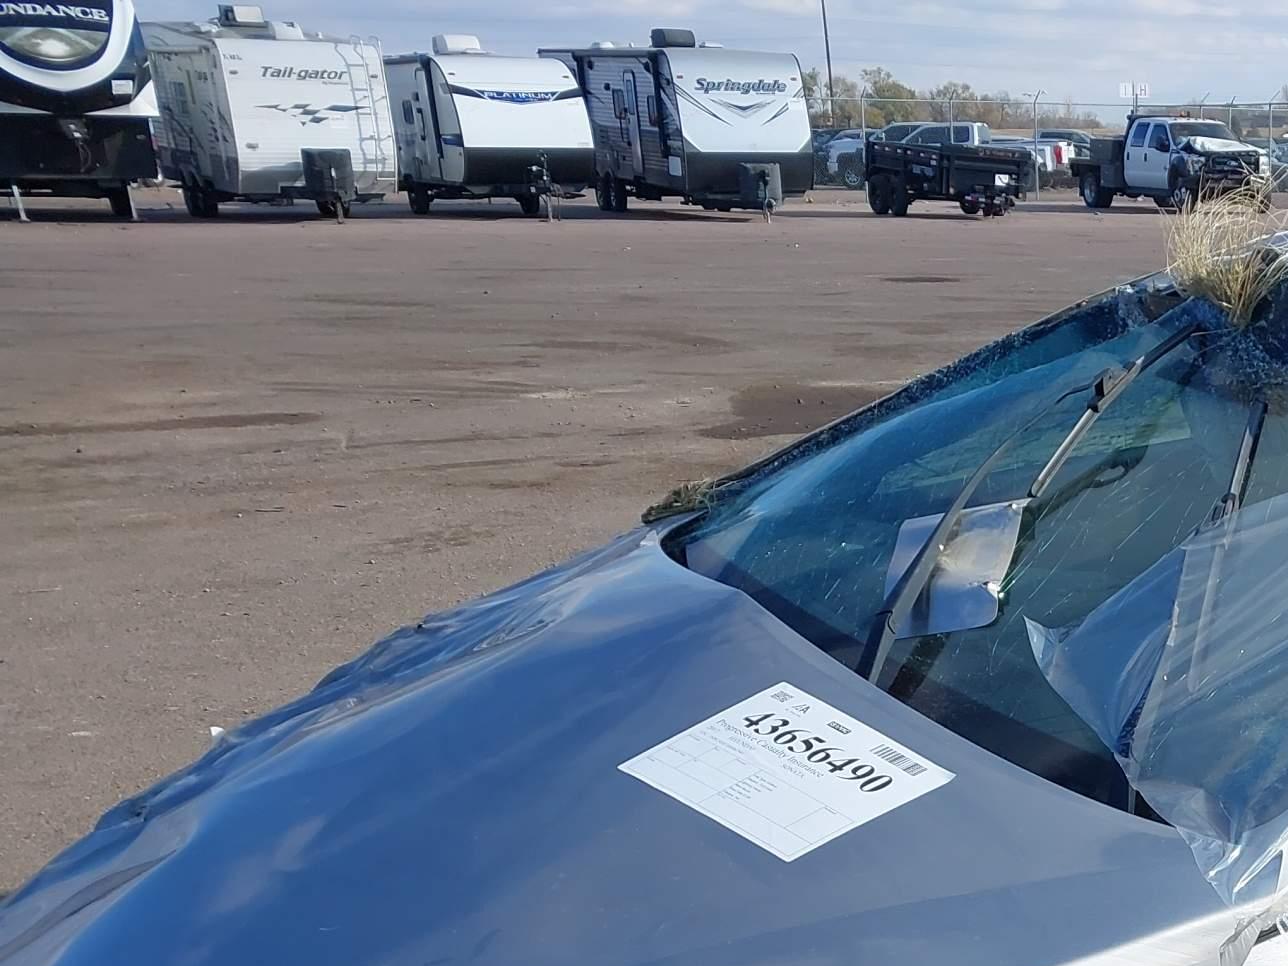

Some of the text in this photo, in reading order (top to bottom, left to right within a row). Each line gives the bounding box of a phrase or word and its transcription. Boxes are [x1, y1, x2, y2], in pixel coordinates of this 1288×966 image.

[260, 66, 348, 81] Tail-gator
[483, 91, 552, 99] PLATINUM
[694, 77, 787, 95] Springdale
[743, 712, 893, 794] 43656490
[787, 756, 825, 778] Insurance
